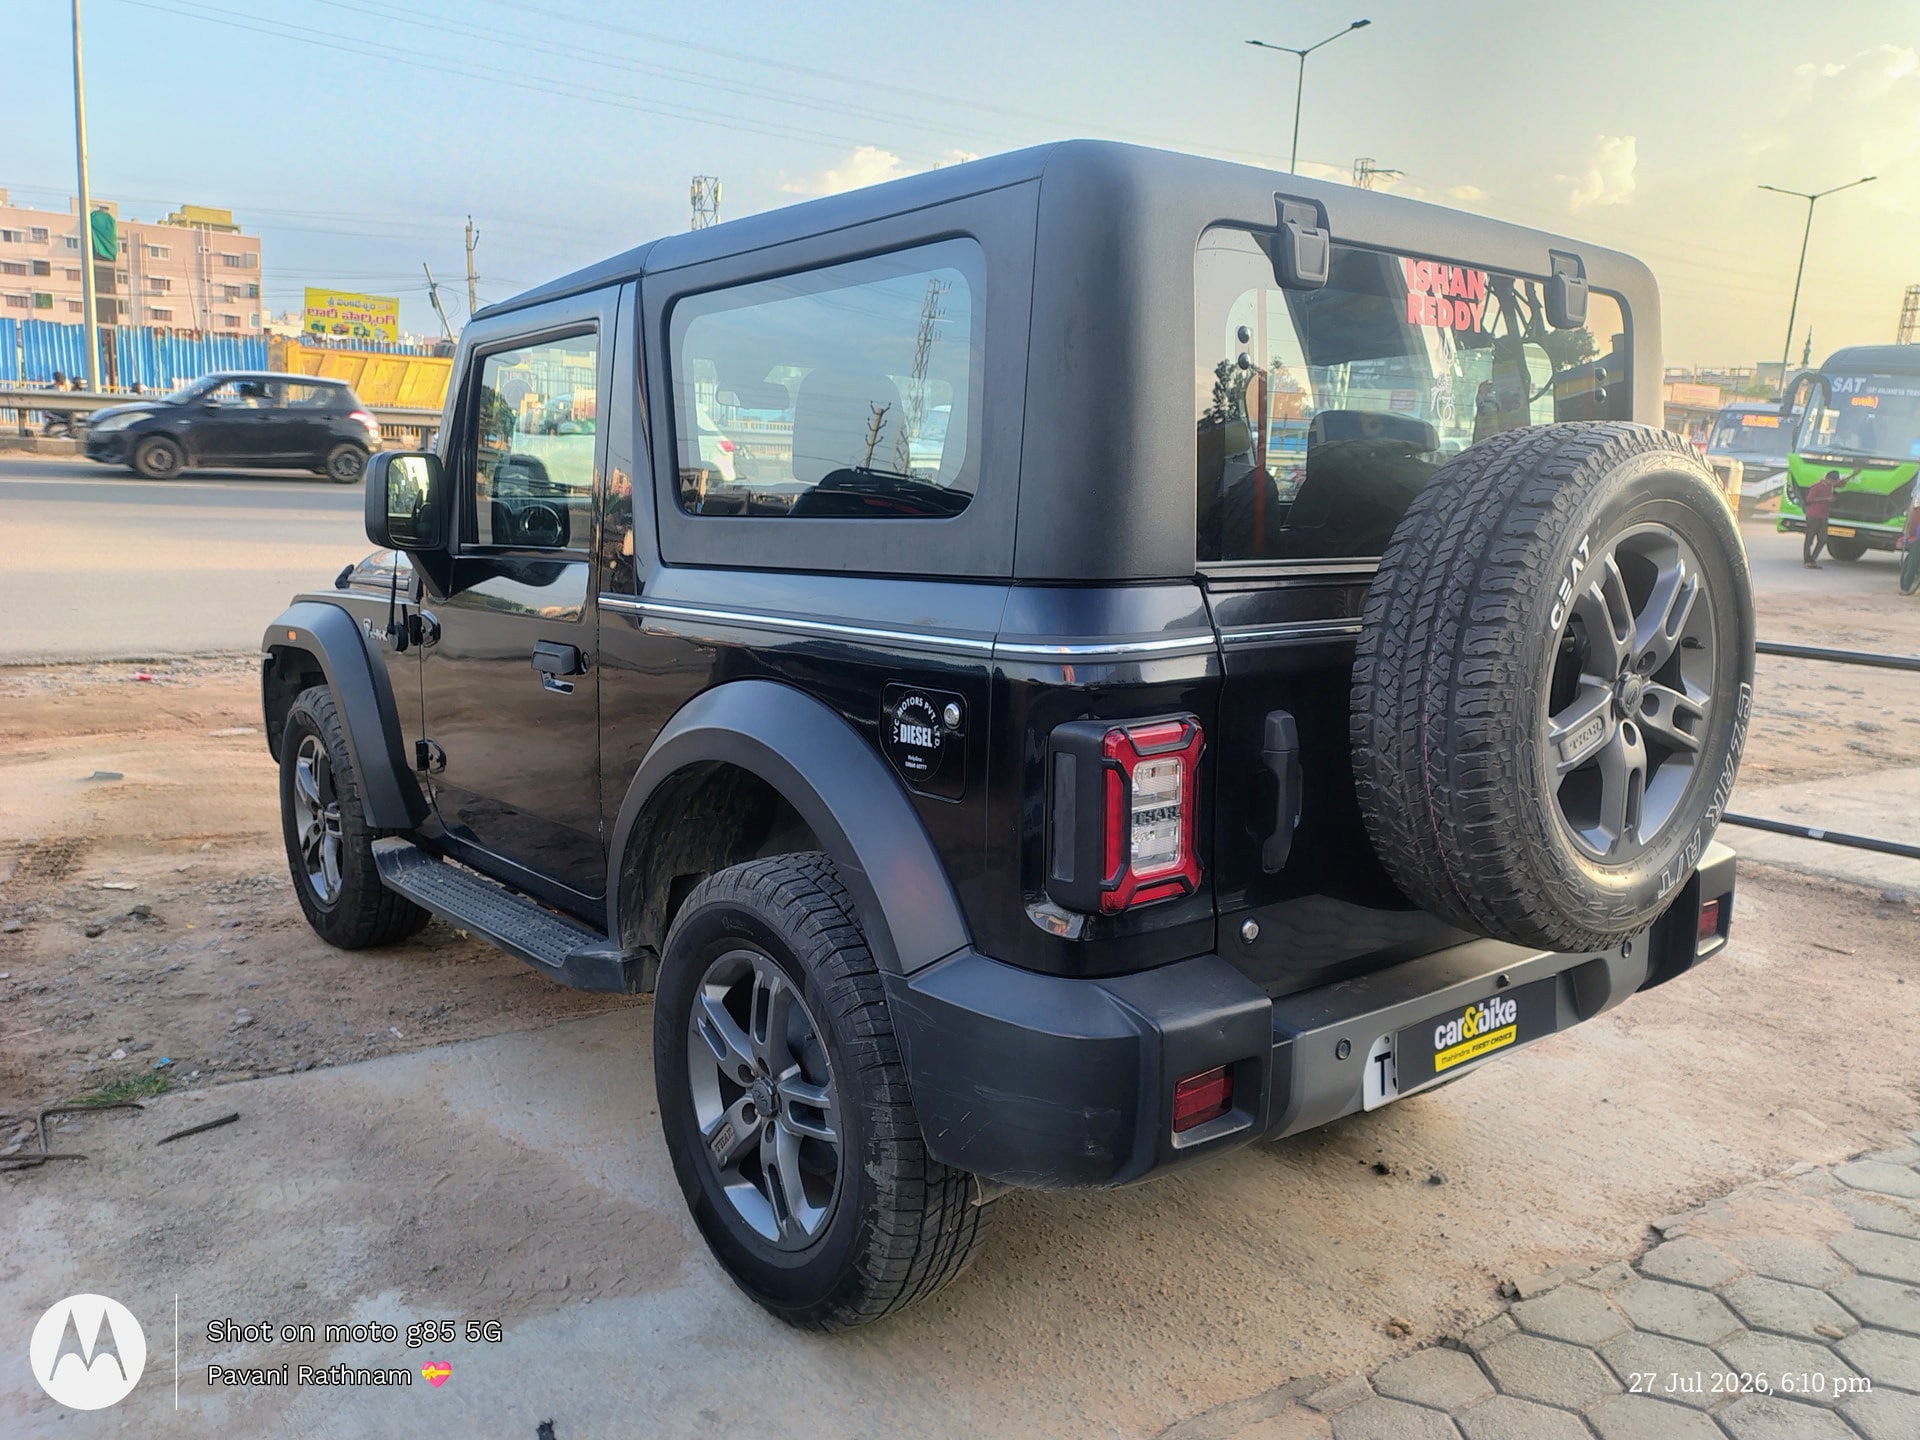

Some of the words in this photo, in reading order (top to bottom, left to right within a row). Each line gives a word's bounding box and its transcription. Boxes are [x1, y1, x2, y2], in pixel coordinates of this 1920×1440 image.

[1405, 257, 1485, 301] ISHAN
[1407, 293, 1484, 333] REDDY
[1832, 377, 1866, 393] SAT
[1550, 534, 1590, 630] CEAT
[897, 696, 924, 717] MOTORS
[900, 723, 933, 748] DIESEL
[1434, 997, 1517, 1050] car&bike
[1472, 1041, 1489, 1052] FIRST
